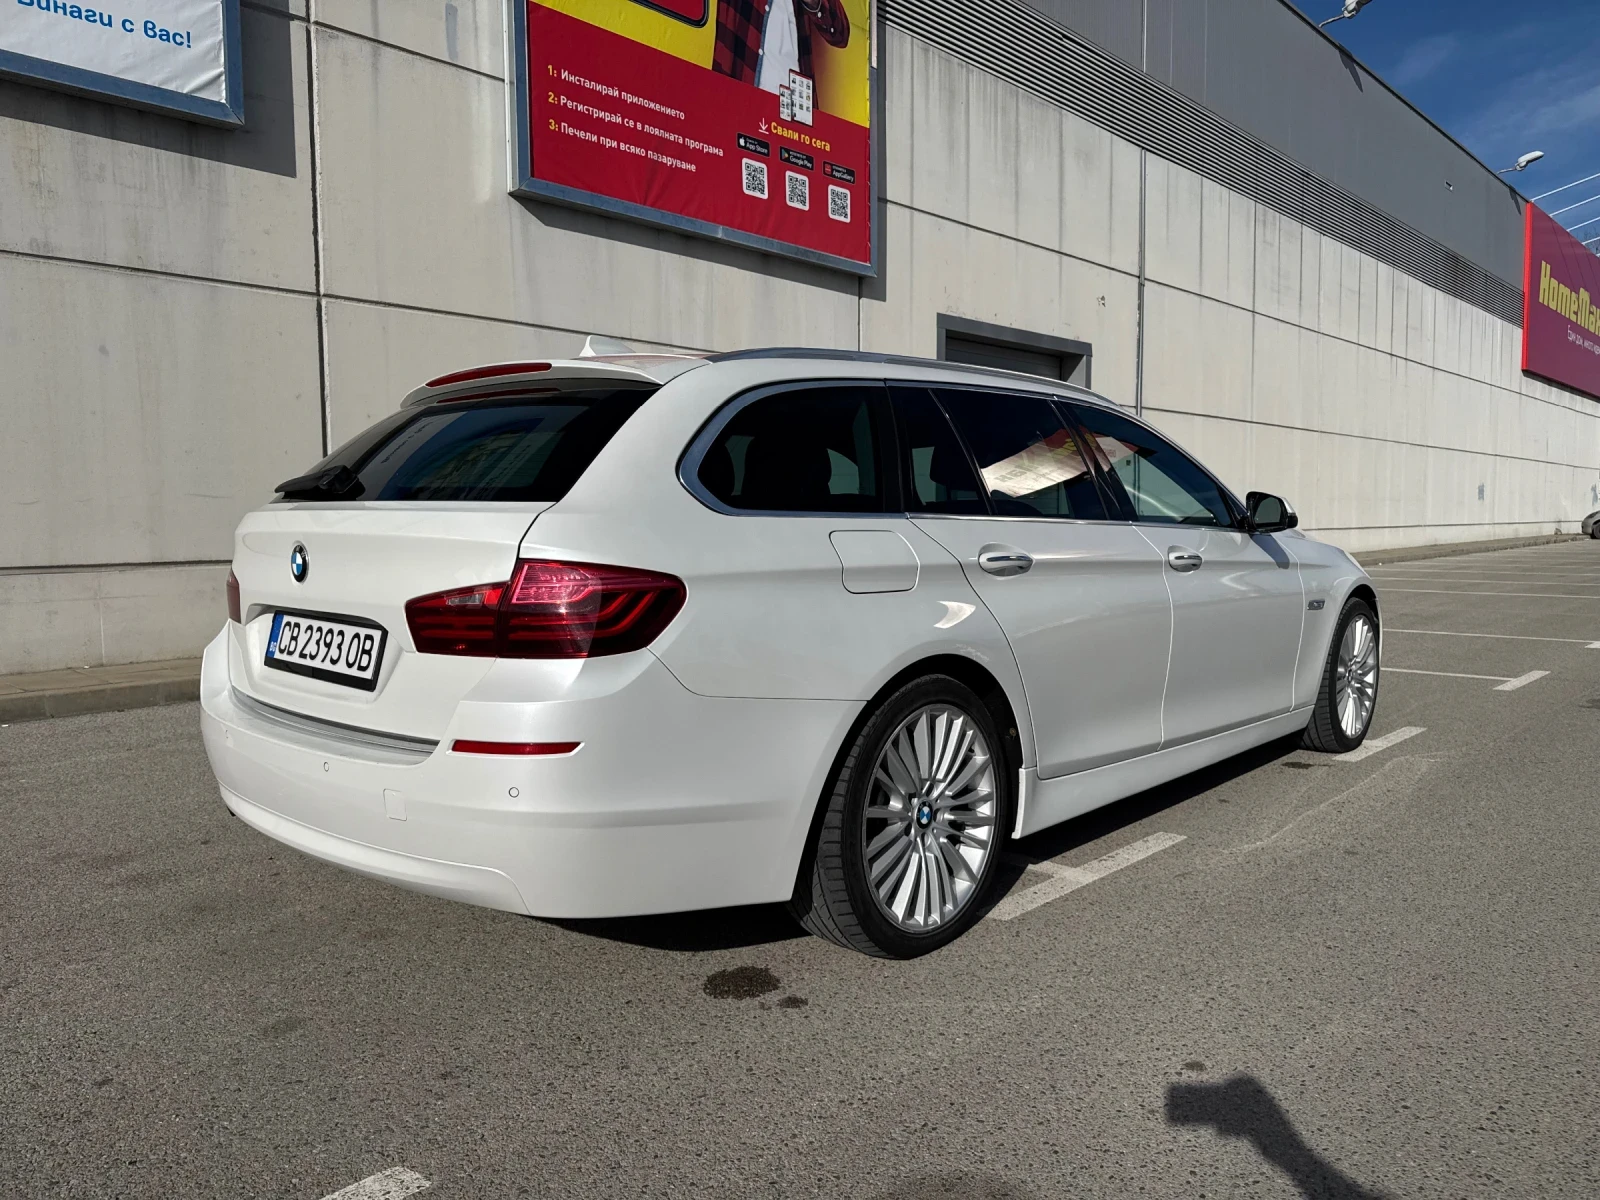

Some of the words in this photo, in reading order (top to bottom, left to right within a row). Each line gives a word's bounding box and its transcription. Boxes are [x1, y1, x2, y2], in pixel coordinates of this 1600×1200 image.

[121, 18, 135, 33] с
[143, 20, 192, 48] вас!
[548, 65, 557, 77] 1:
[561, 69, 619, 98] Инсталирай
[621, 91, 685, 120] приложението
[548, 92, 558, 104] 2:
[560, 95, 622, 124] Регистрирай
[624, 118, 635, 128] се
[636, 122, 642, 131] в
[644, 124, 683, 144] лоялната
[685, 138, 724, 157] програма
[771, 121, 799, 141] Свали
[800, 133, 811, 145] го
[812, 137, 831, 152] сега
[549, 119, 559, 131] 3:
[561, 122, 598, 143] Печели
[600, 136, 618, 148] при
[620, 142, 646, 157] всяко
[647, 150, 697, 172] пазаруване
[746, 142, 756, 151] App
[789, 155, 804, 166] Google
[804, 160, 813, 169] Play
[278, 621, 301, 656] CB
[298, 624, 345, 666] 2393
[345, 632, 375, 672] OB
